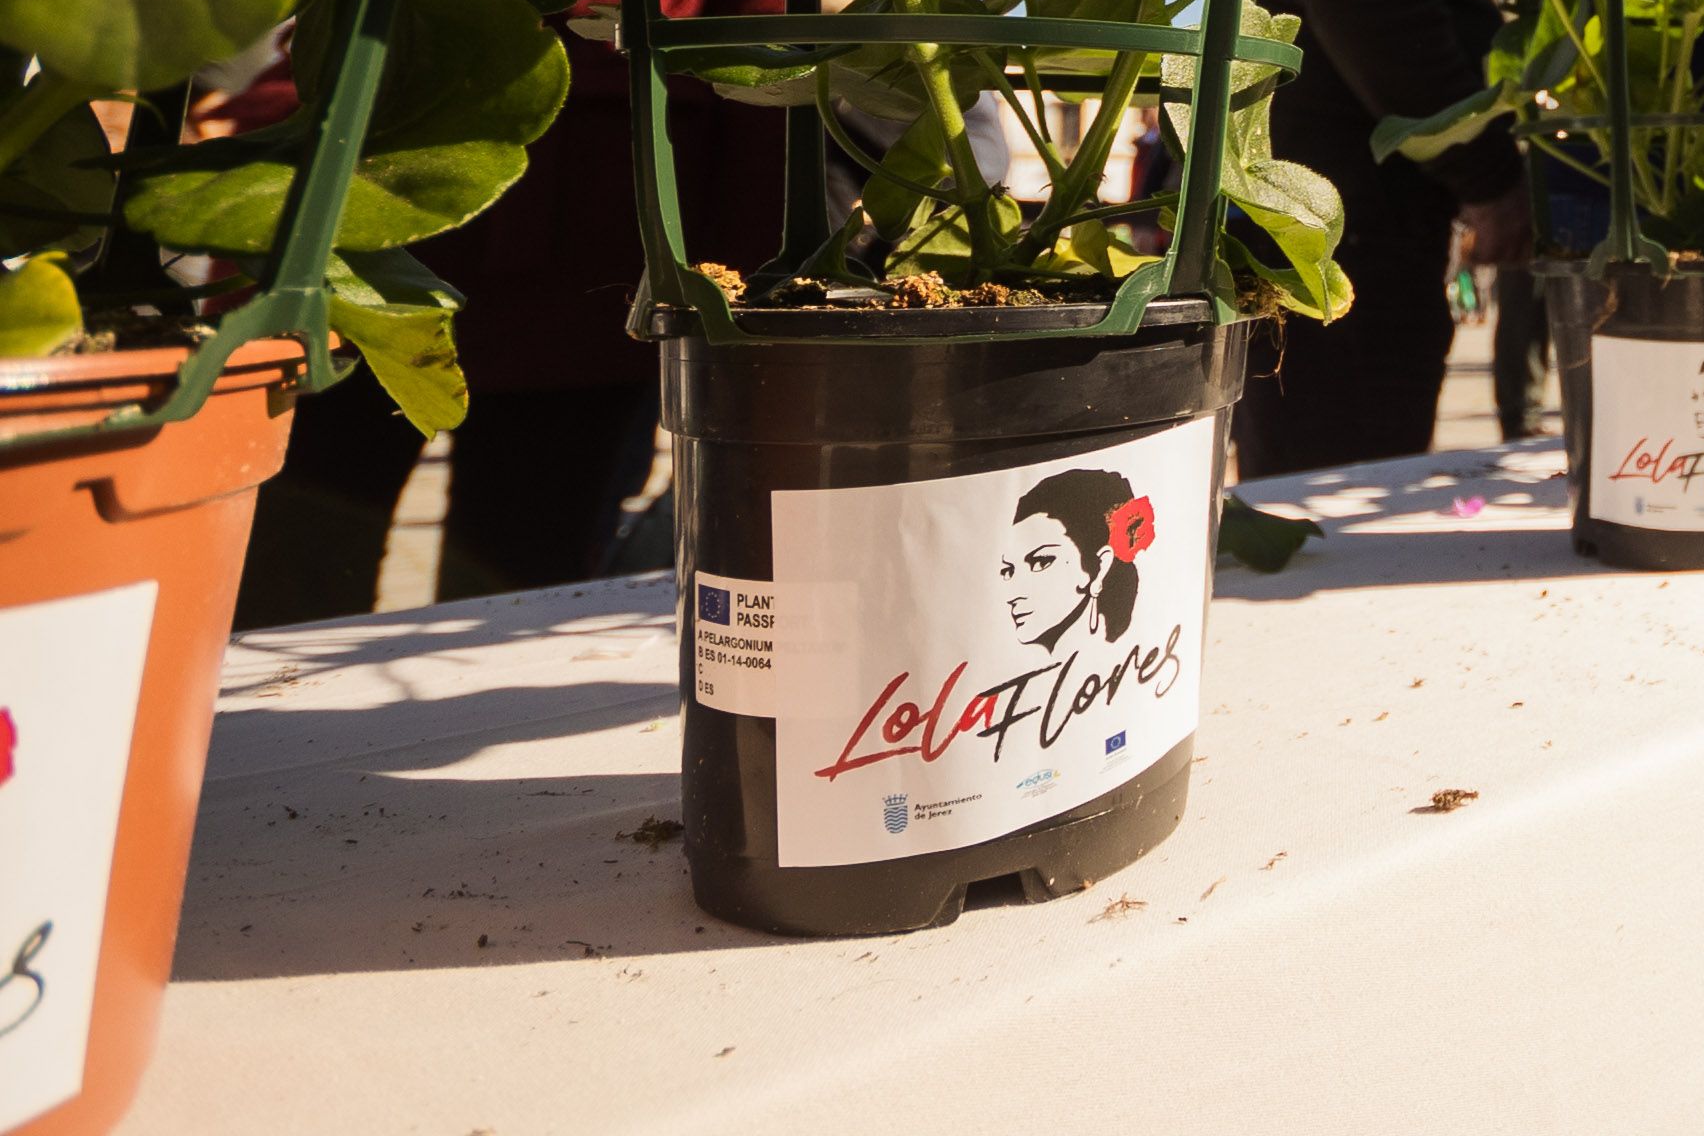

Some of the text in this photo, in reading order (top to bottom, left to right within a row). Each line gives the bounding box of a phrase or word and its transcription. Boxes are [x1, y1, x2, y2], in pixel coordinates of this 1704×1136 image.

[1608, 437, 1687, 484] Lola
[704, 631, 773, 652] PELARGONIUM
[705, 649, 716, 662] ES
[717, 653, 772, 670] 01-14-0064
[705, 682, 714, 695] ES
[814, 624, 1181, 782] Lola Flores
[914, 793, 983, 812] Ayuntamiento
[914, 809, 953, 821] de Jerez
